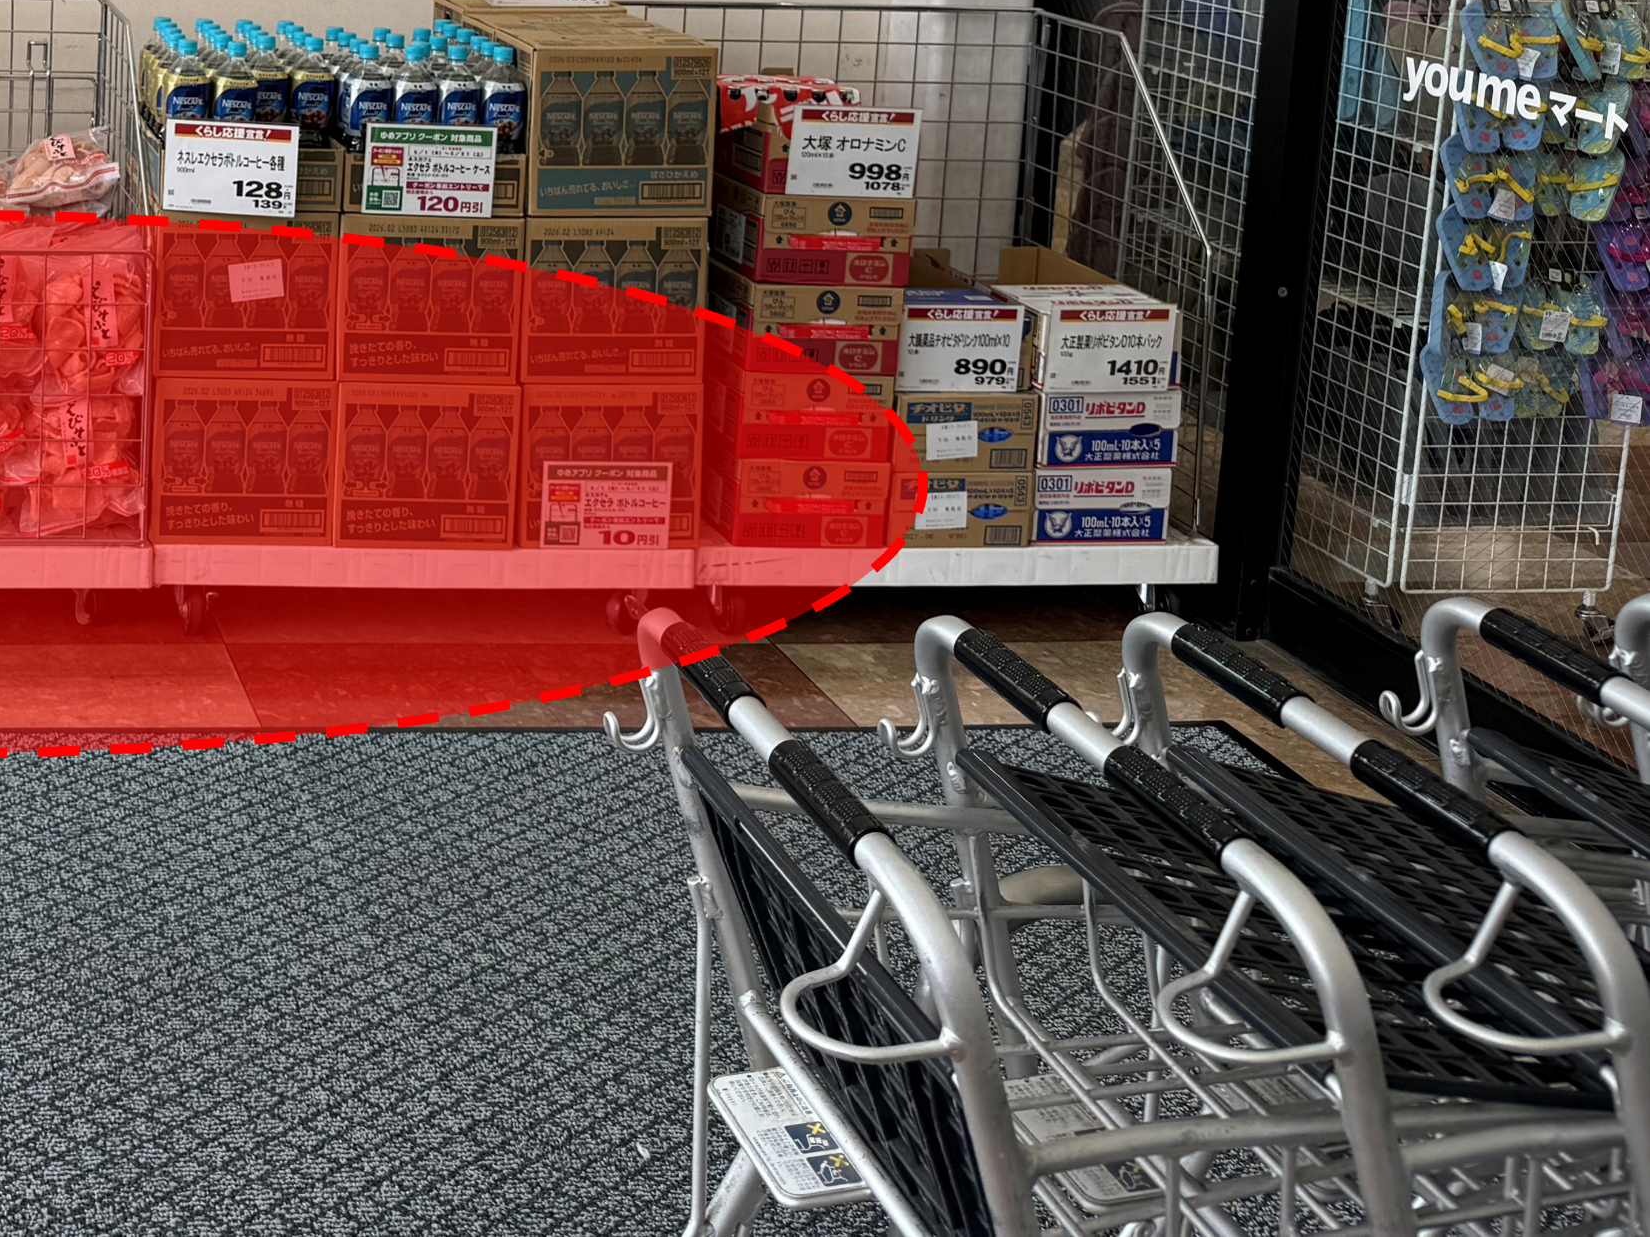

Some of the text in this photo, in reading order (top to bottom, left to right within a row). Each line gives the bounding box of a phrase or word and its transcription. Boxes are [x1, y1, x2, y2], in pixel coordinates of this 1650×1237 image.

[1403, 57, 1629, 140] youme マート
[380, 131, 416, 140] ゆめアプリ
[418, 132, 448, 141] クーポン
[802, 135, 906, 153] 大塚 オロナミンC
[177, 149, 285, 171] ネスレエクセラボトルコーヒー各種
[407, 162, 491, 175] エクセラ ボトルコーヒー ケース
[863, 181, 901, 191] 1078
[252, 199, 283, 209] 139
[974, 376, 1006, 385] 979
[1122, 376, 1157, 386] 1551
[1052, 399, 1146, 415] 0301 リポビタンD
[1041, 478, 1135, 494] 0301 リポビタンD
[584, 498, 614, 508] エクセラ
